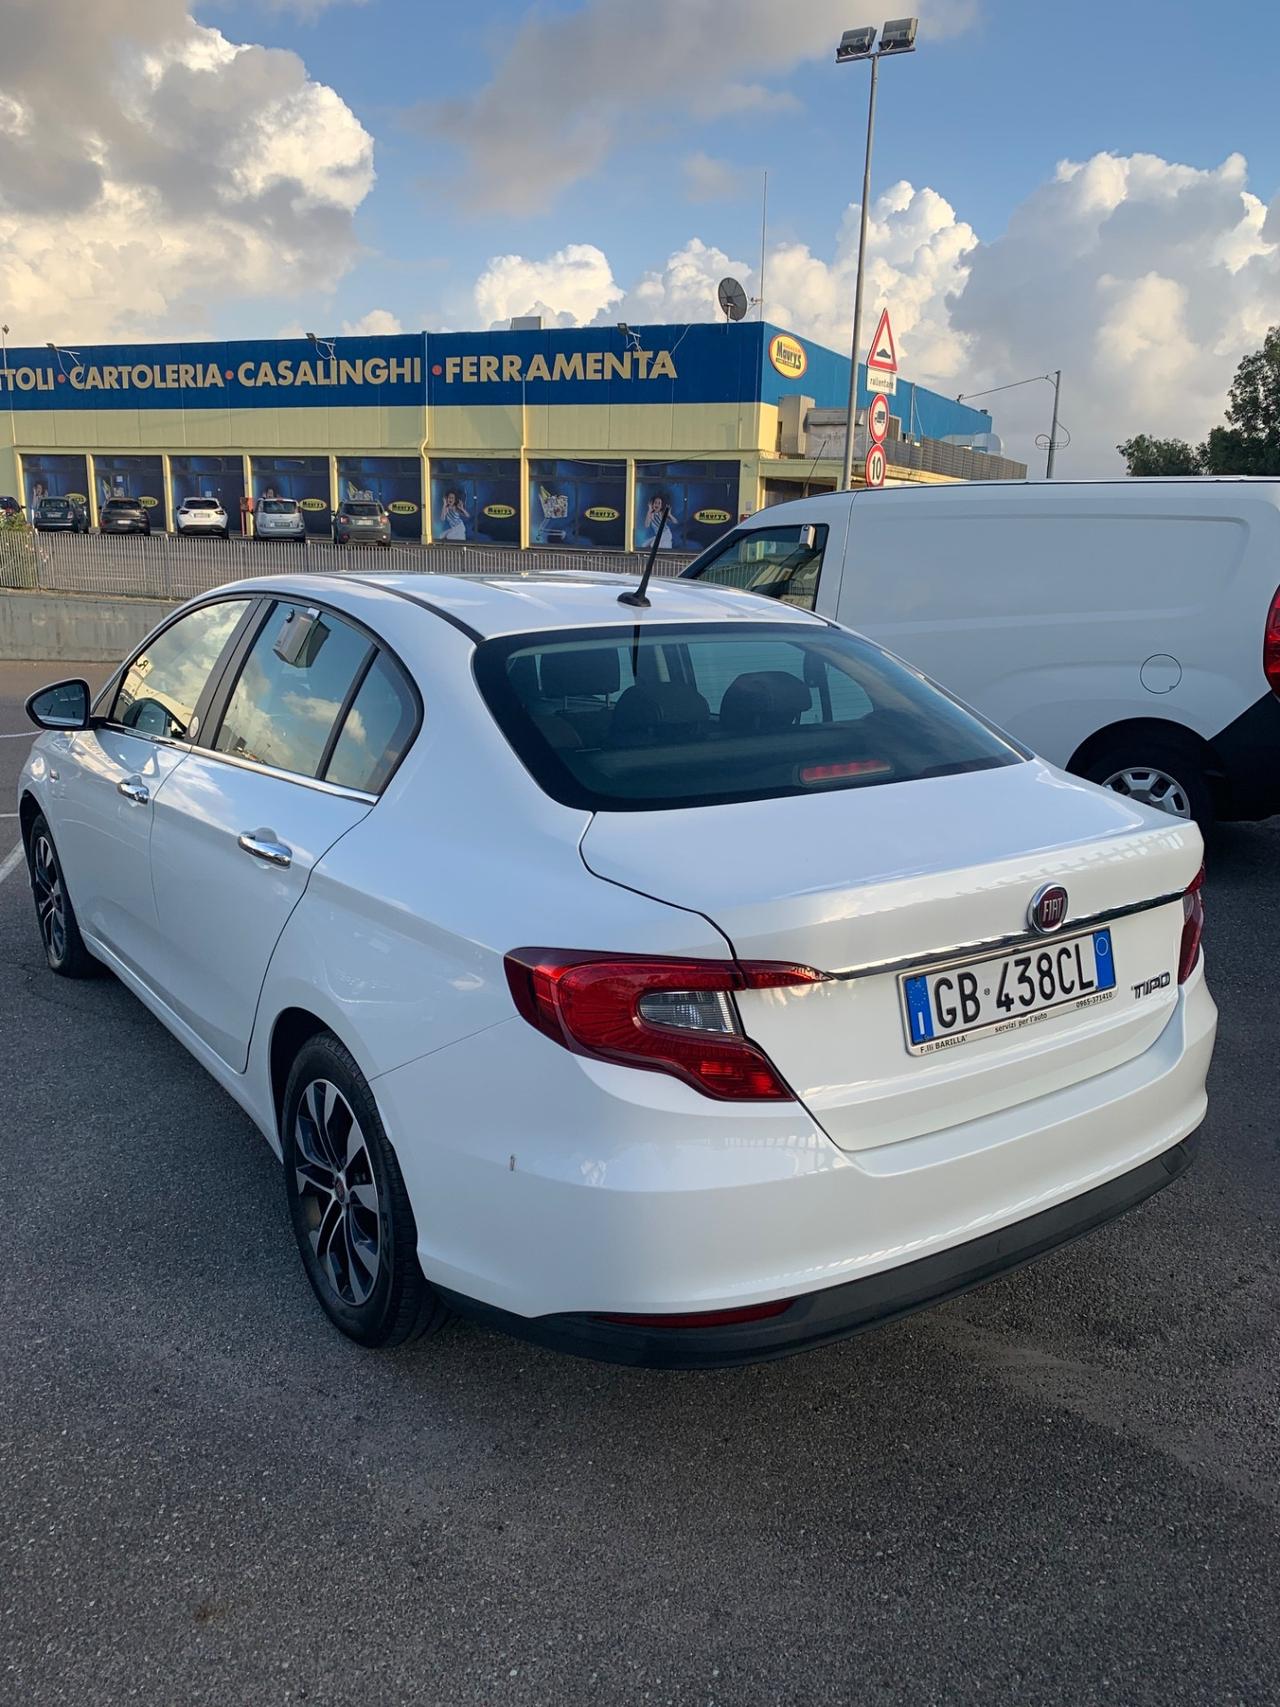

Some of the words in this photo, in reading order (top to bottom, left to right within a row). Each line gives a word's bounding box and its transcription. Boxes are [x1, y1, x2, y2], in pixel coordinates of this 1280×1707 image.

[69, 363, 224, 390] CARTOLERIA
[237, 357, 421, 387] CASALINGHI
[445, 350, 678, 384] FERRAMENTA
[872, 456, 882, 480] 10
[1042, 897, 1063, 922] FIAT
[934, 971, 981, 1028] GB
[996, 943, 1095, 1013] 438CL
[1133, 971, 1171, 1000] TIPO
[994, 1022, 1017, 1033] servizi
[1018, 1018, 1030, 1027] per
